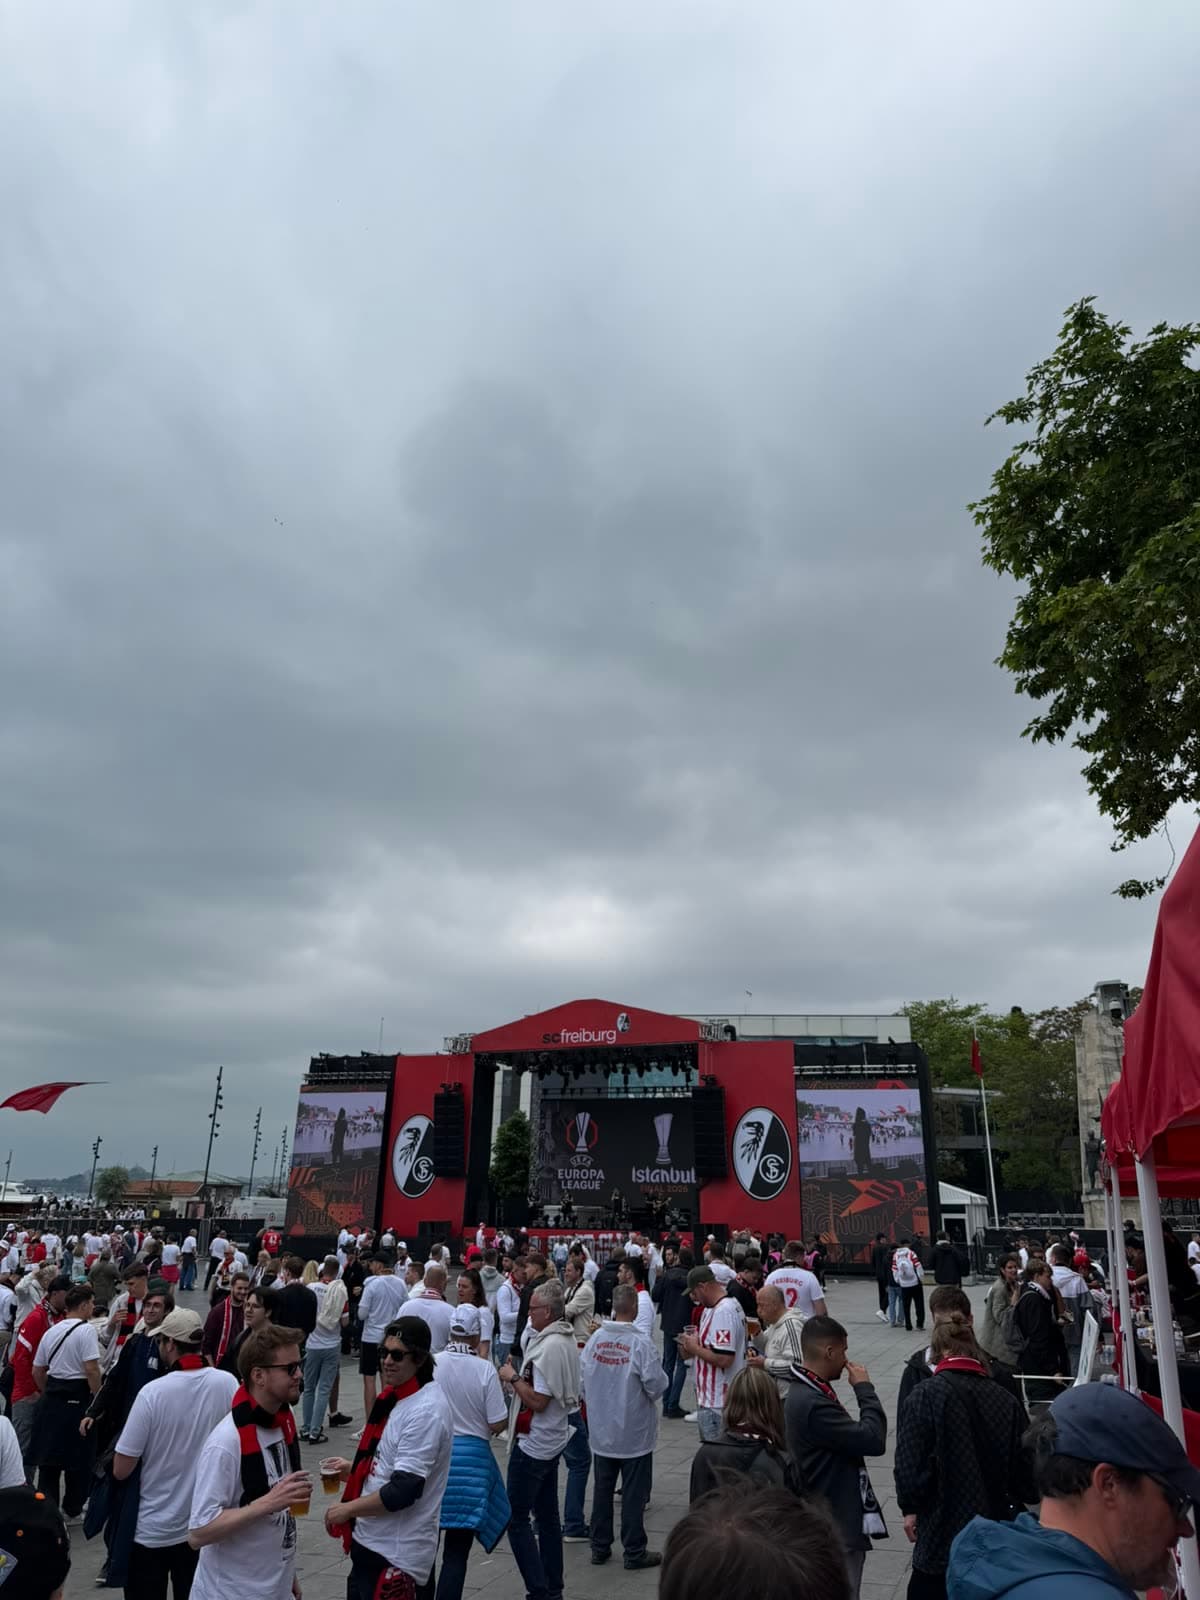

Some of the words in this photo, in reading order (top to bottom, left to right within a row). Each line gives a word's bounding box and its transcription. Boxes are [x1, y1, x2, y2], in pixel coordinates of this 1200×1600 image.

[570, 1154, 594, 1167] UEFA
[557, 1168, 606, 1180] EUROPA
[631, 1166, 697, 1184] Istanbul
[561, 1180, 601, 1190] LEAGUE
